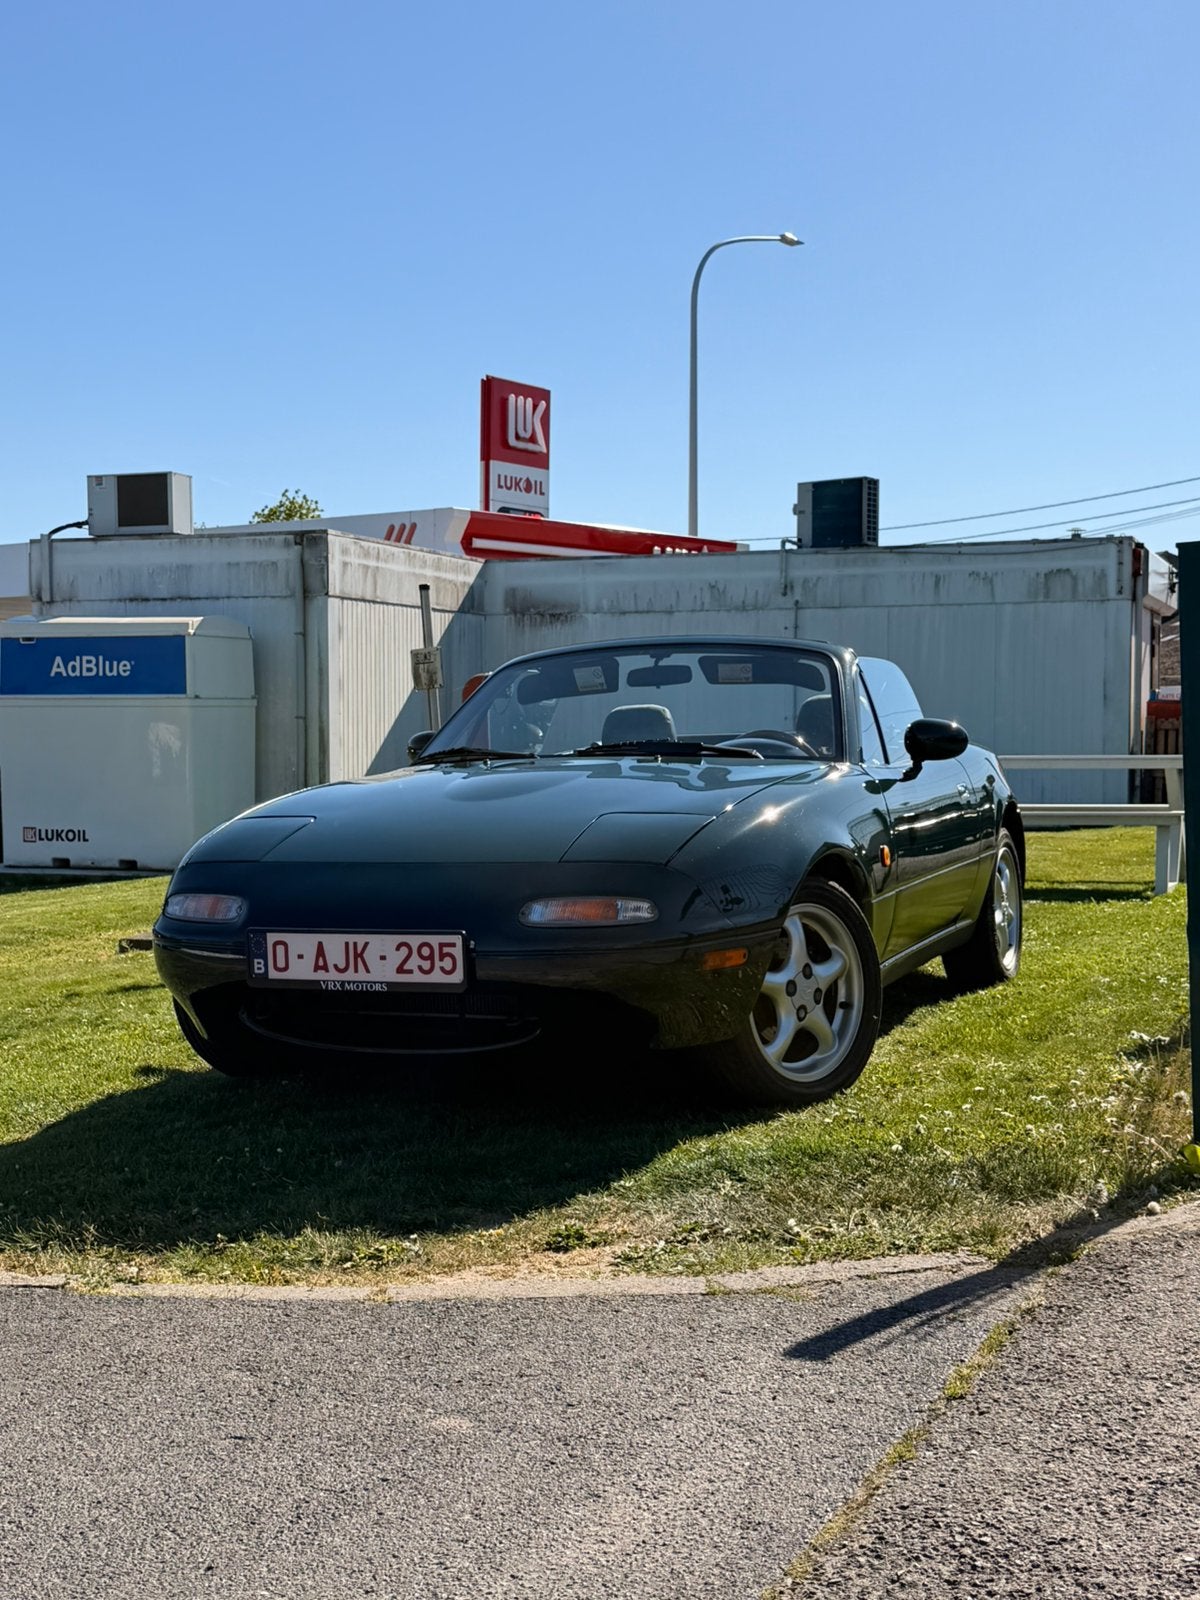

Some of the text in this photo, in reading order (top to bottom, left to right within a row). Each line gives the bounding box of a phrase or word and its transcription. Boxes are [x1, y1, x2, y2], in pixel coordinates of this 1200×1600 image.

[497, 473, 545, 496] LUKOIL
[50, 655, 132, 677] AdBlue
[38, 828, 89, 842] LUKOIL
[254, 958, 265, 974] B
[320, 980, 388, 992] VRX MOTORS
